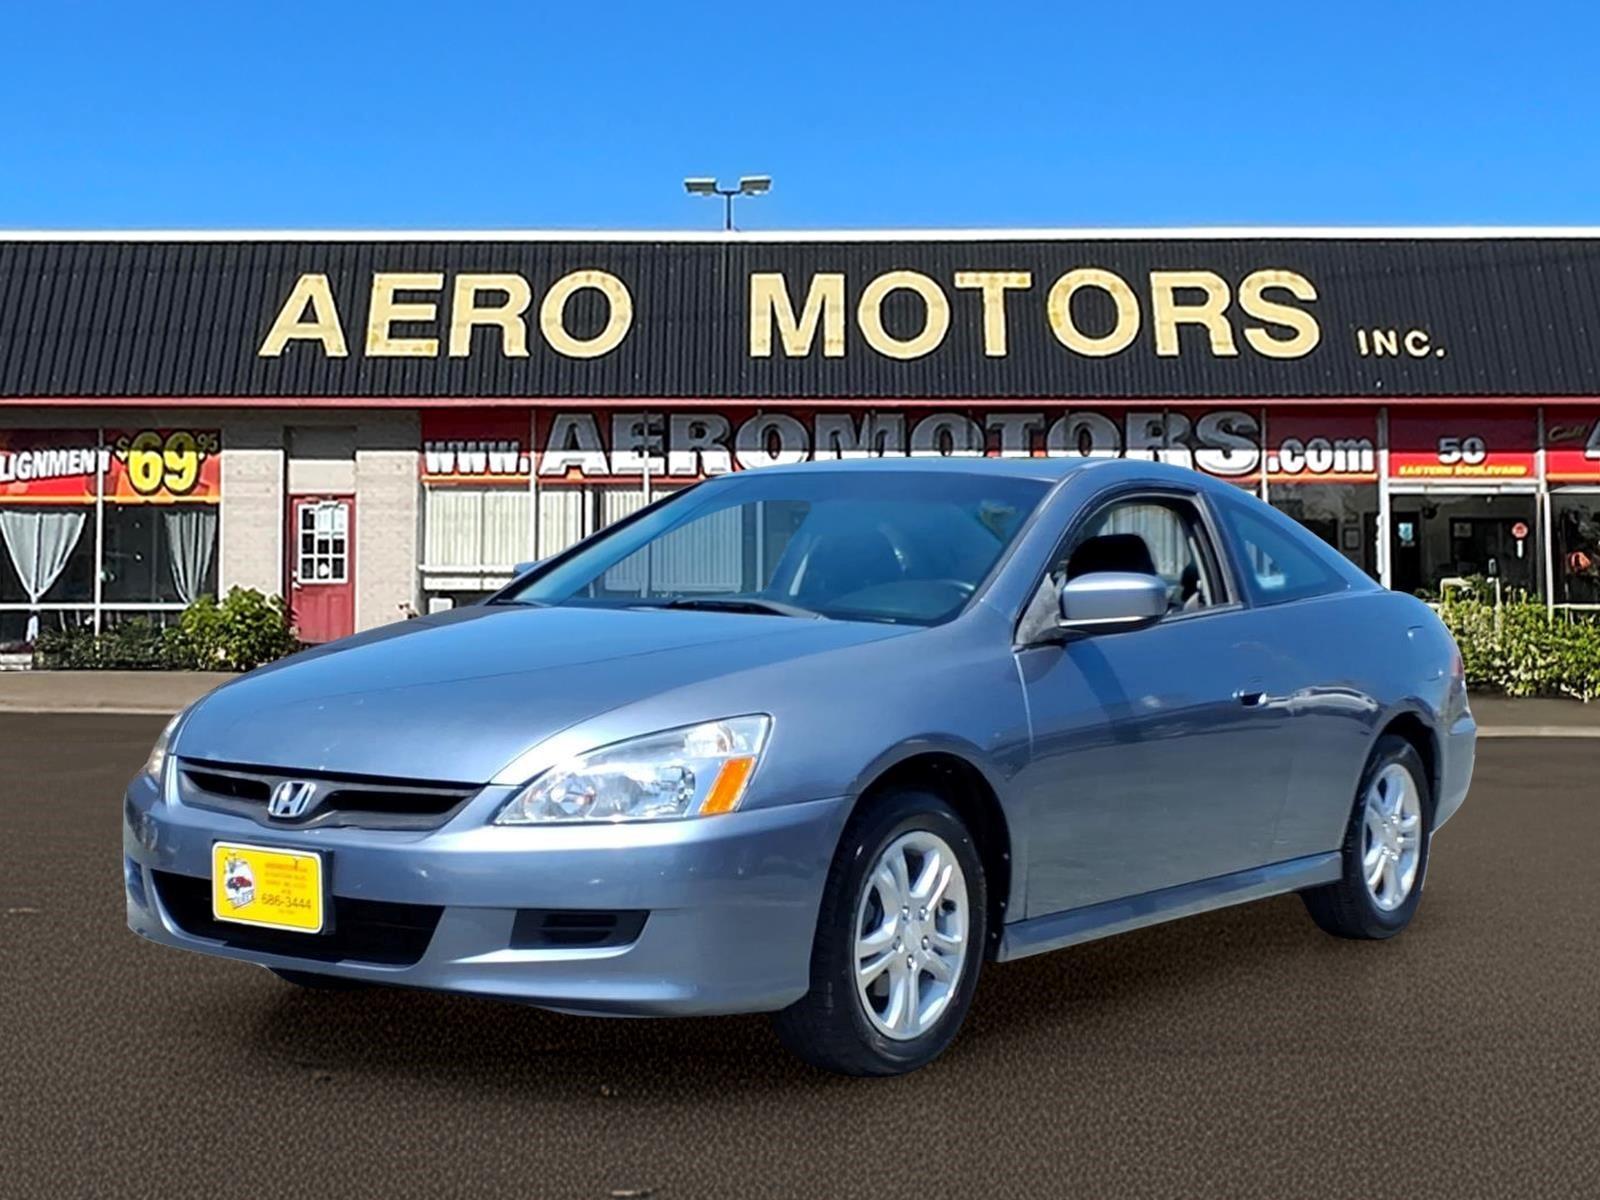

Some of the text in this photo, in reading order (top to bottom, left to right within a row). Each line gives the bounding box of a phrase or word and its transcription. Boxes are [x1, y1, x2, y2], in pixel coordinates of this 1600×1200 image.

[258, 267, 1447, 361] AERO MOTORS INC.
[1438, 436, 1486, 465] 50
[261, 893, 312, 909] 686-3444
